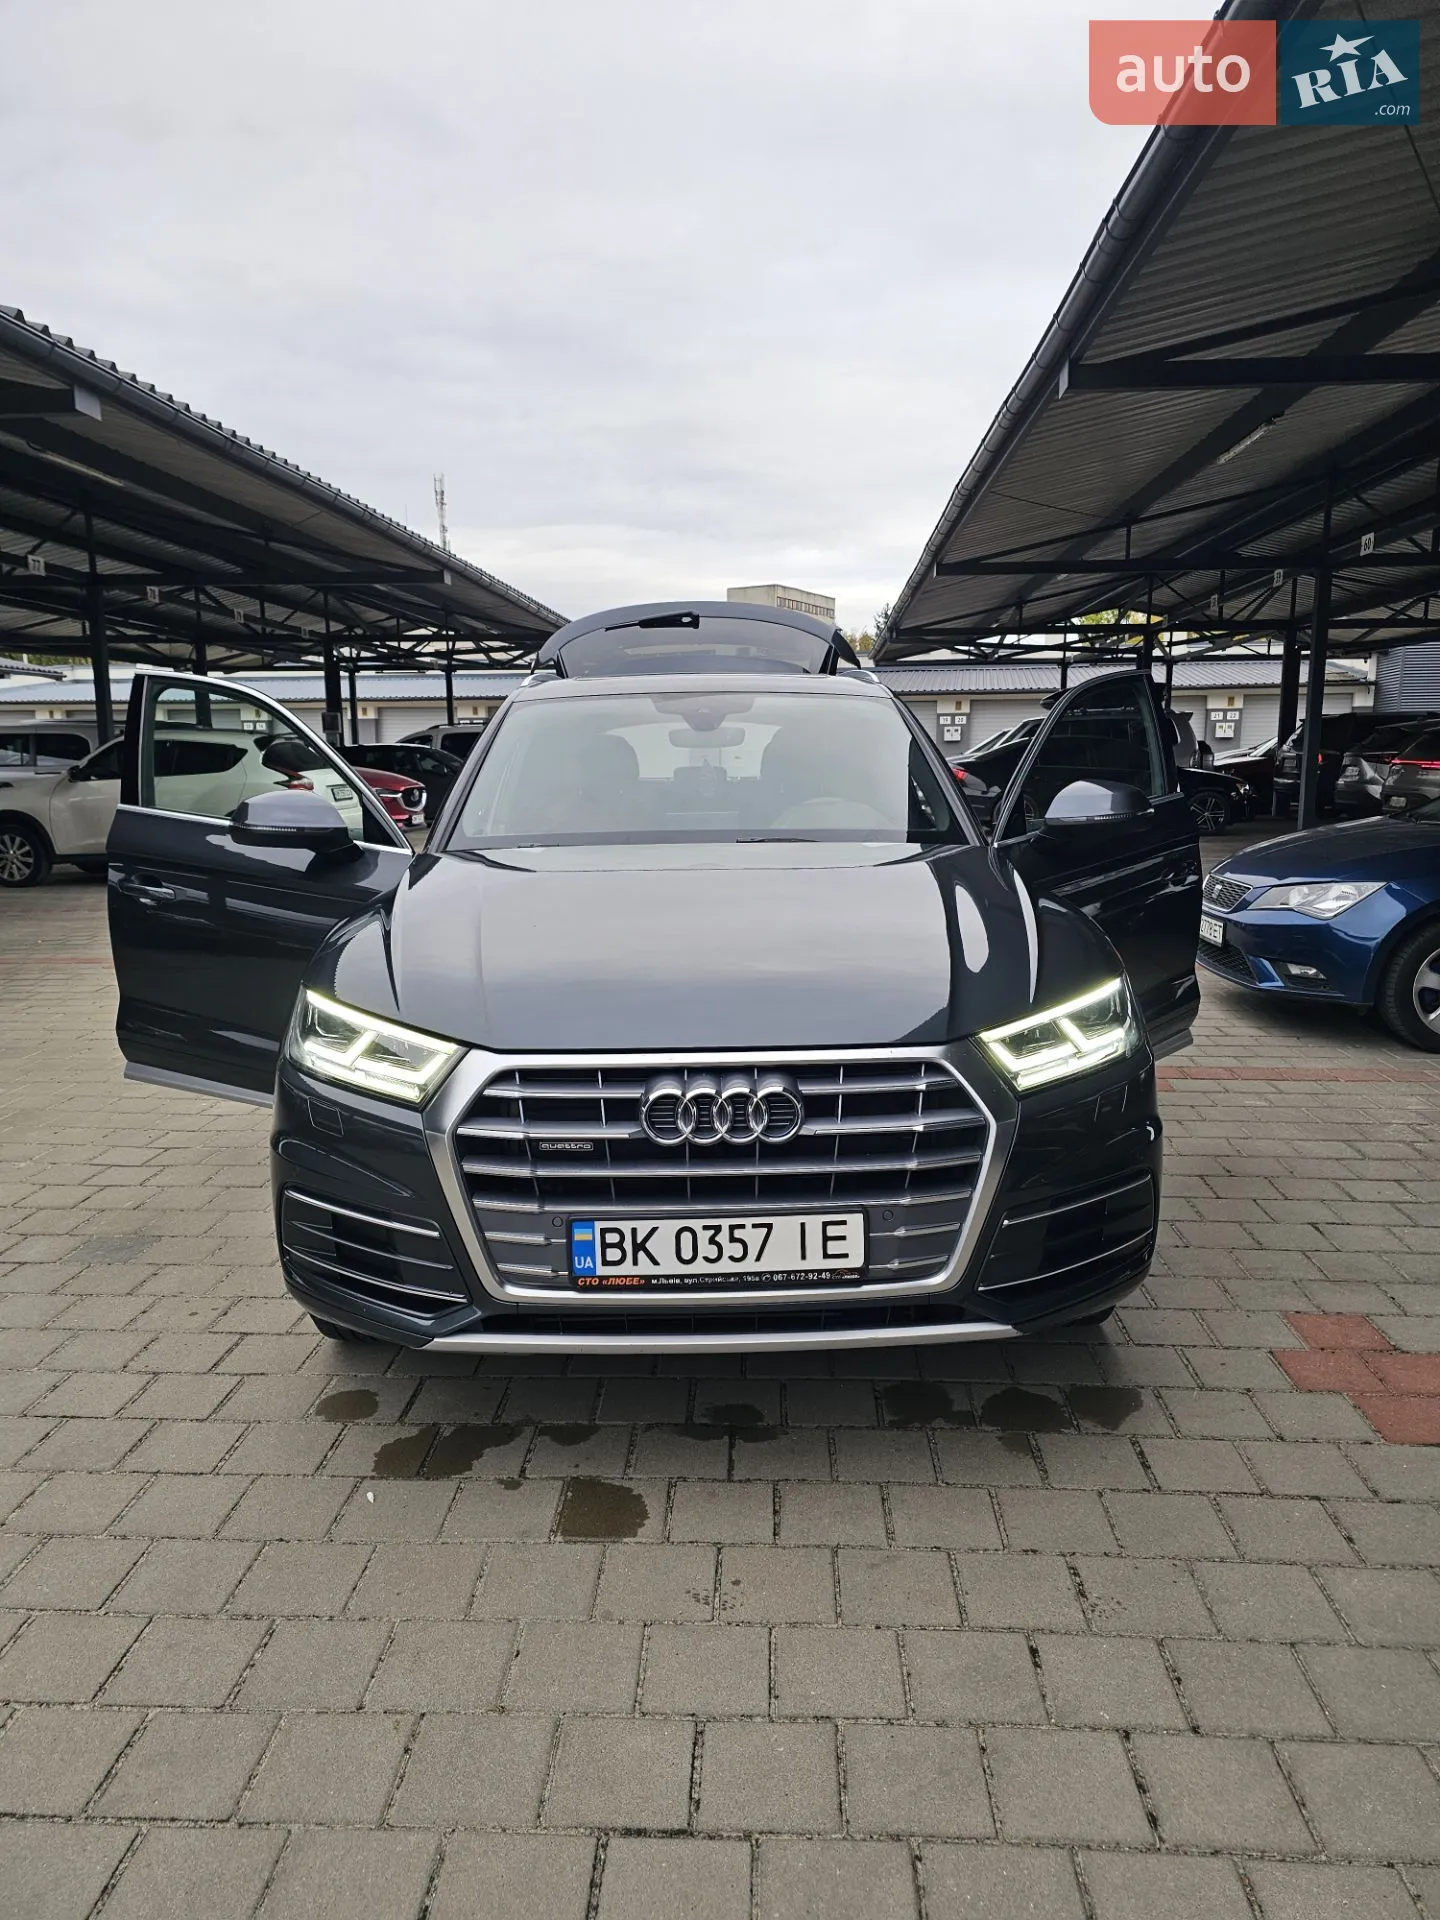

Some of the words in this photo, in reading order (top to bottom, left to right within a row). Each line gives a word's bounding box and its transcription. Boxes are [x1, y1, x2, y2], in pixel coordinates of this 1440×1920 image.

[600, 1226, 661, 1266] BK
[674, 1222, 773, 1265] 0357
[800, 1220, 849, 1260] IE
[574, 1256, 594, 1268] UA
[577, 1278, 599, 1286] СТО
[773, 1271, 831, 1281] 067-672-92-49
